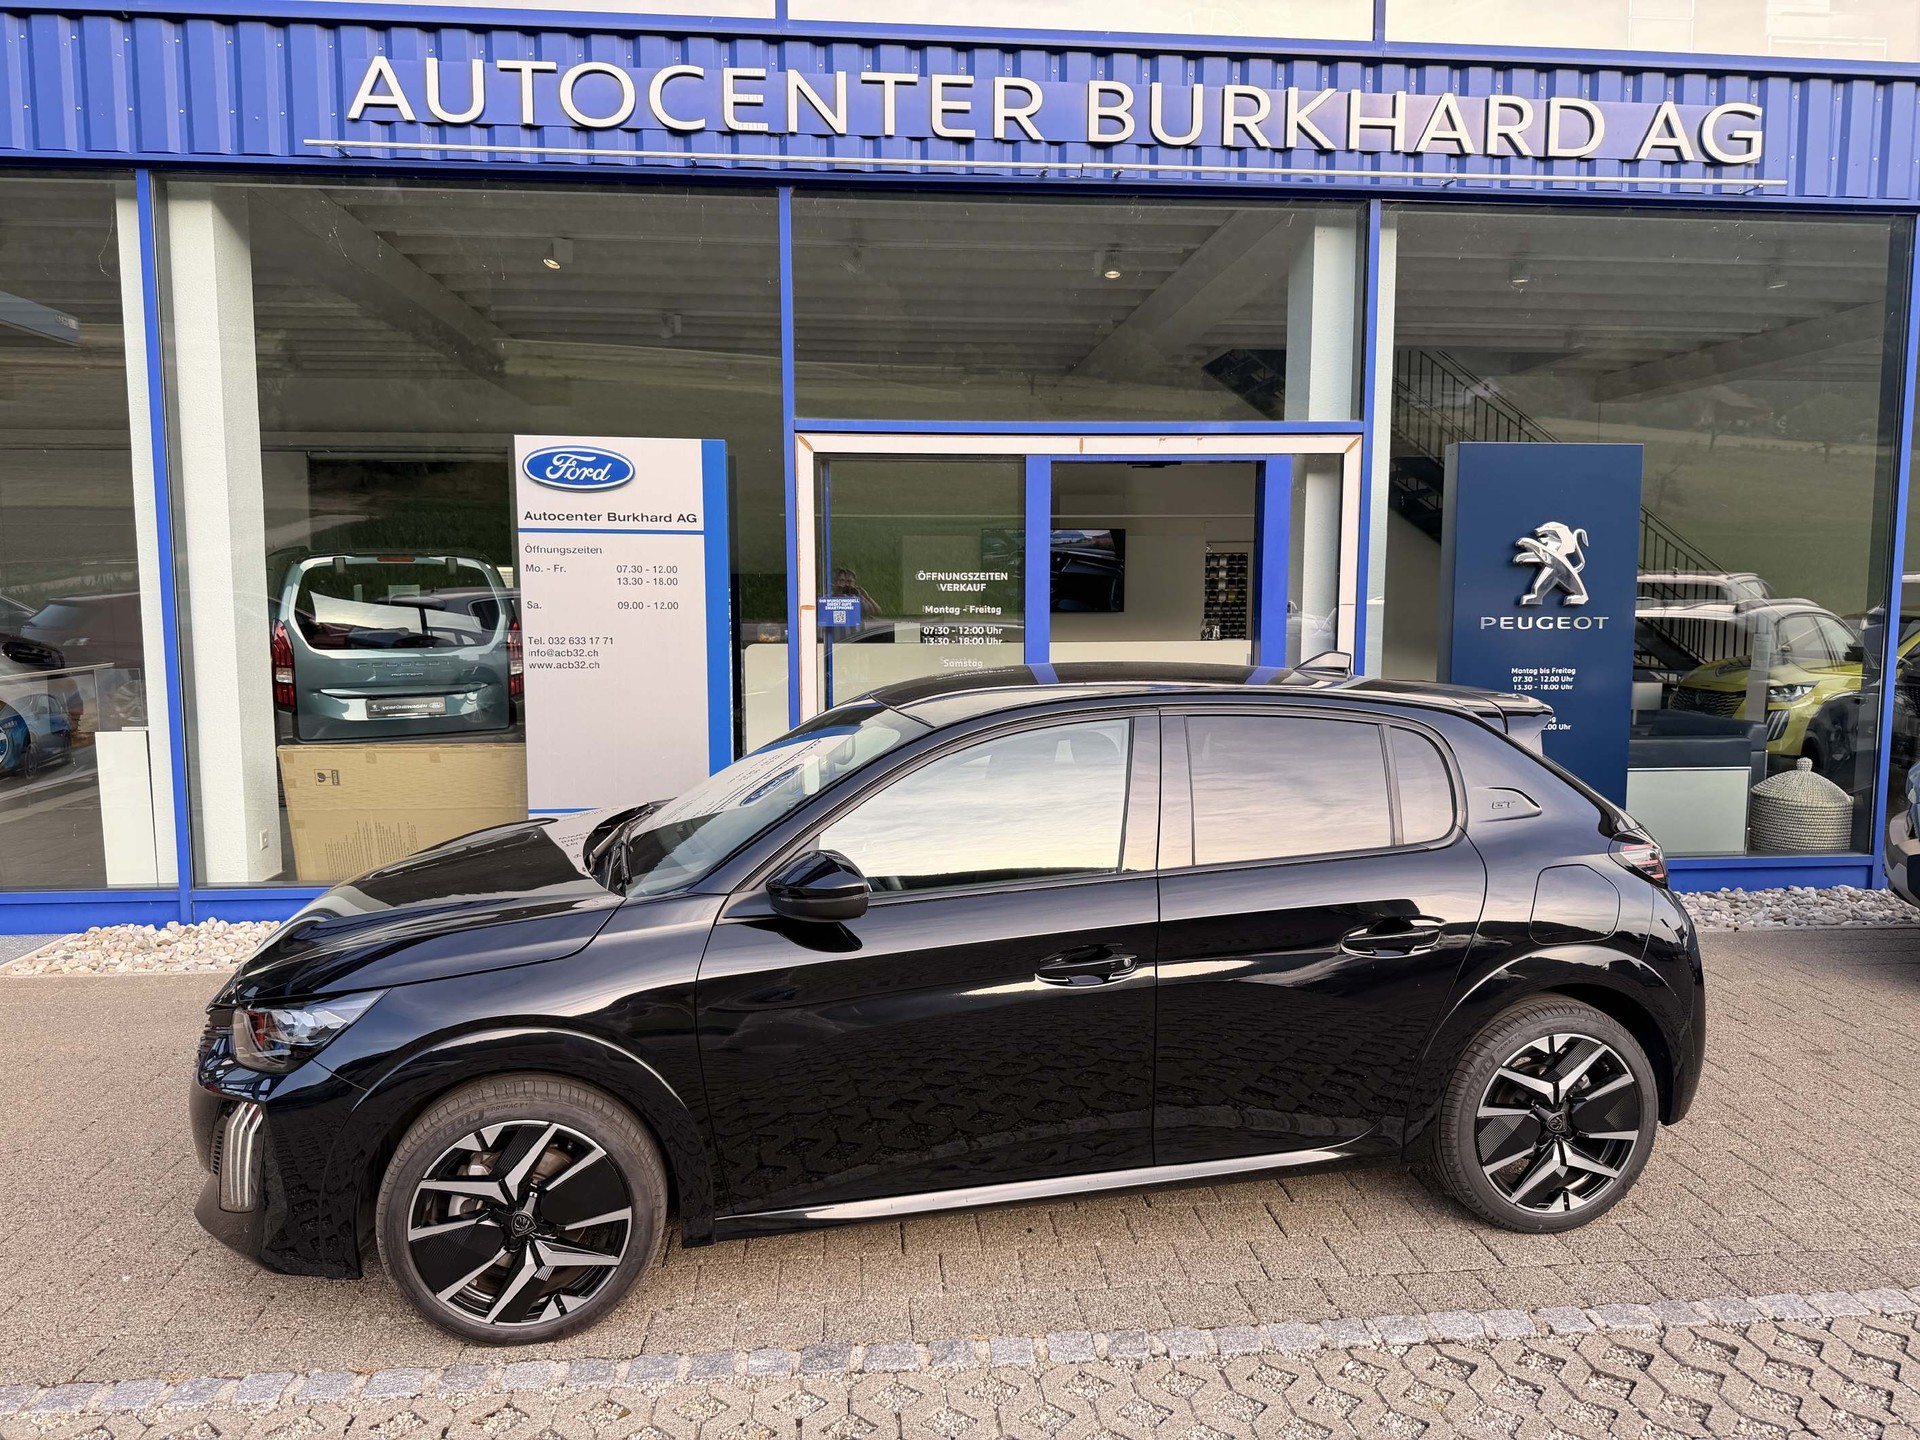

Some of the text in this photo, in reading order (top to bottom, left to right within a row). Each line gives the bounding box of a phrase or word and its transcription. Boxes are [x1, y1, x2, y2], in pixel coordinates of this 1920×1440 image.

[348, 56, 1764, 164] AUTOCENTER BURKHARD AG
[546, 454, 613, 482] Ford
[524, 511, 697, 524] Autocenter Burkhard AG
[525, 543, 602, 555] Öffnungszeiten
[525, 564, 544, 573] Mo.
[554, 564, 566, 573] Fr.
[616, 565, 643, 574] 07.30
[652, 565, 678, 574] 12.00
[917, 570, 1008, 581] ÖFFNUNGSZEITEN
[617, 577, 643, 586] 13.30
[653, 578, 678, 586] 18.00
[940, 584, 986, 592] VERKAUF
[527, 601, 542, 610] Sa.
[618, 601, 644, 610] 09.00
[654, 602, 679, 610] 12.00
[925, 605, 960, 615] Montag
[969, 605, 1002, 615] Freitag
[1480, 616, 1609, 630] PEUGEOT
[924, 626, 949, 635] 07:30
[958, 627, 983, 635] 12:00
[986, 627, 1003, 635] Uhr
[528, 636, 614, 645] Tel. 032 633 17 71
[924, 637, 949, 645] 13:30
[958, 638, 983, 646] 18:00
[986, 638, 1003, 646] Uhr
[528, 648, 599, 658] info@acb32.ch
[529, 660, 600, 670] www.acb32.ch
[943, 659, 983, 668] Samstag
